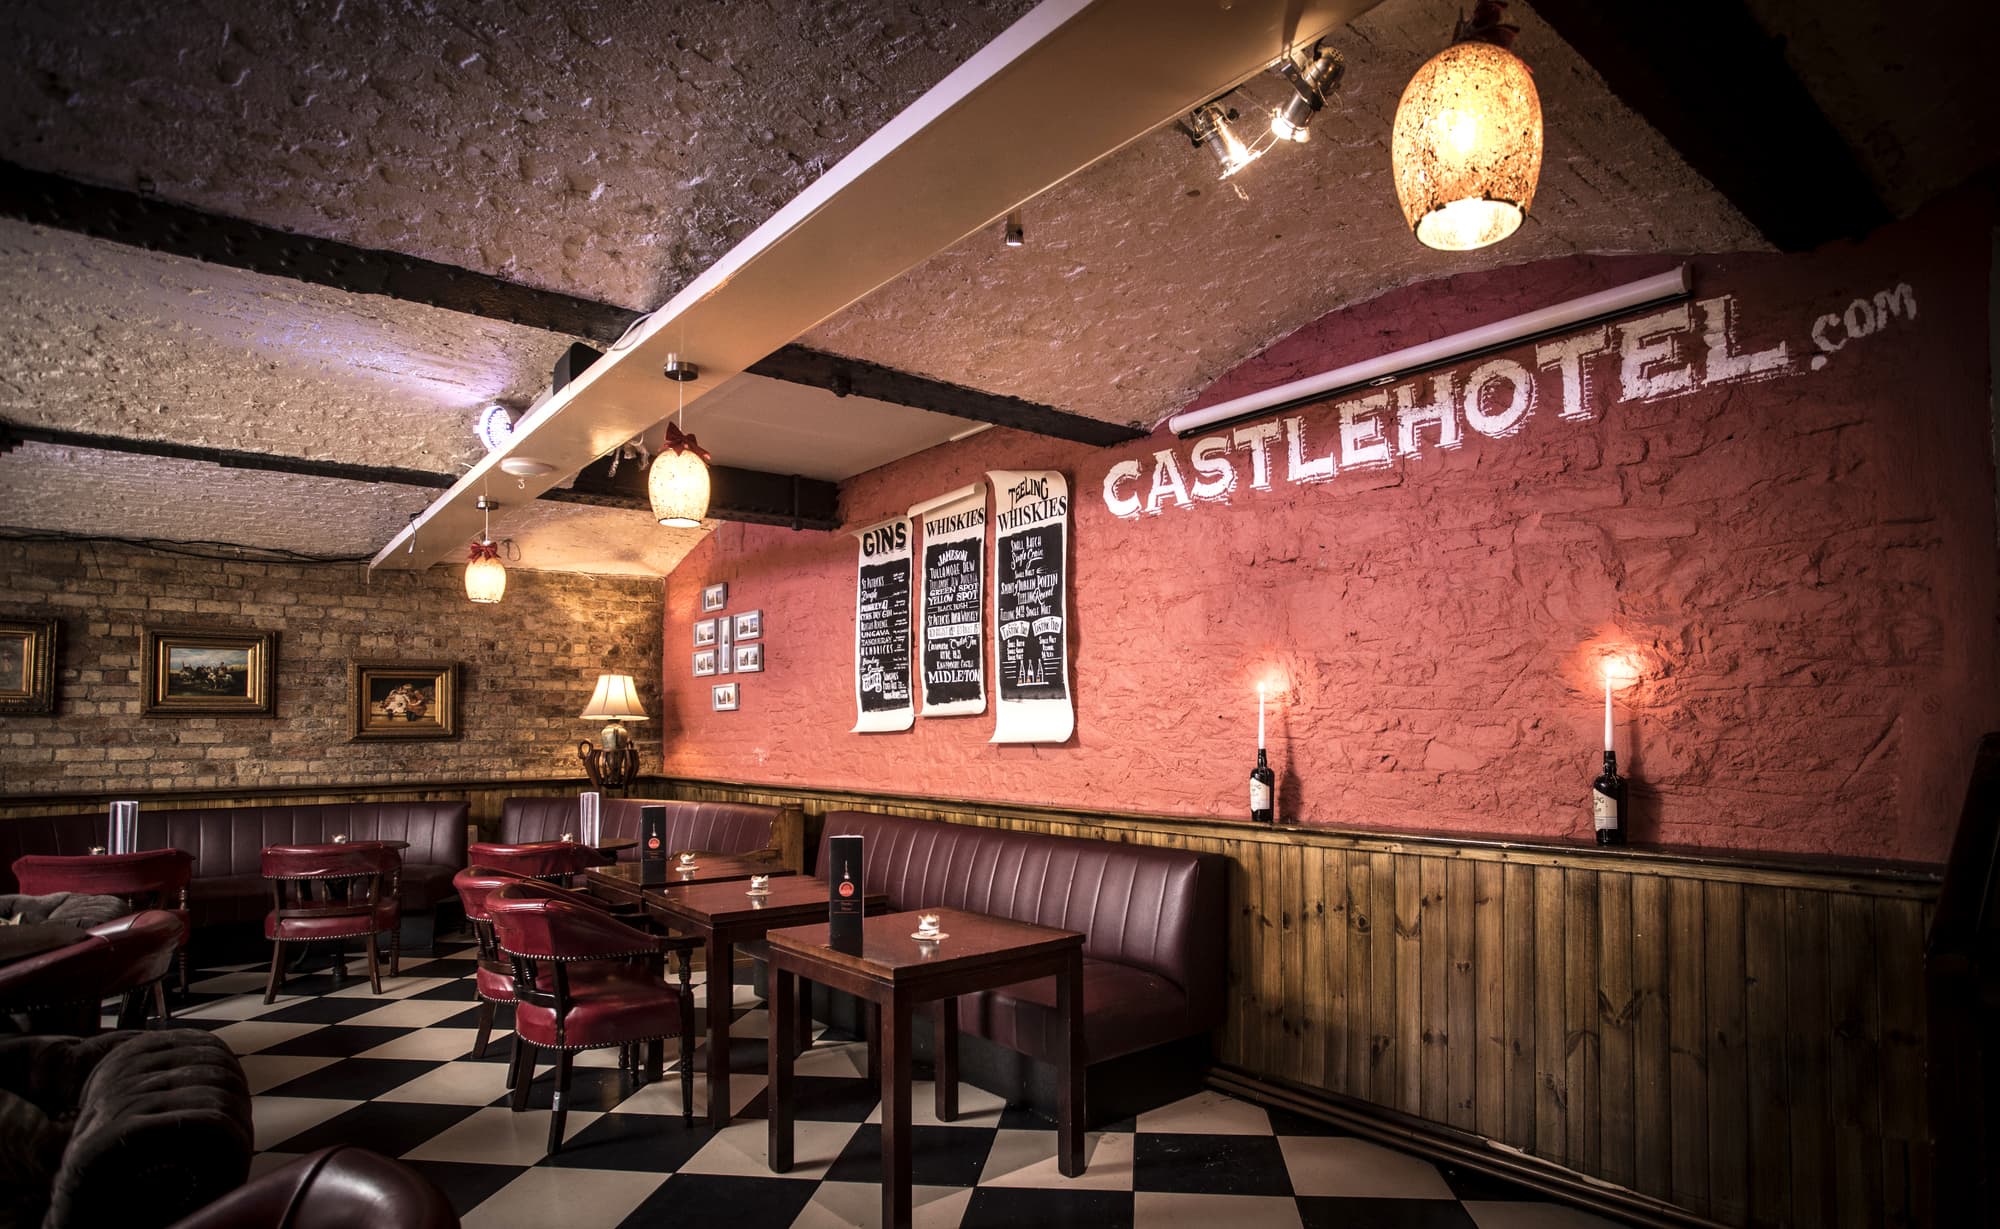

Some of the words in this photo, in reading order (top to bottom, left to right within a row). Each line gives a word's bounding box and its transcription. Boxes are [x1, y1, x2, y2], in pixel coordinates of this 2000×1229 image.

[1008, 476, 1049, 510] TEELING
[926, 507, 985, 538] WHISKIES
[998, 496, 1067, 532] WHISKIES
[863, 522, 906, 557] GINS
[937, 549, 968, 567] JAMESON
[962, 560, 975, 575] DEW
[928, 594, 953, 606] YELLOW
[957, 590, 978, 602] SPOT
[930, 586, 956, 597] GREEN
[959, 583, 979, 592] SPOT
[928, 669, 980, 684] MIDLETON
